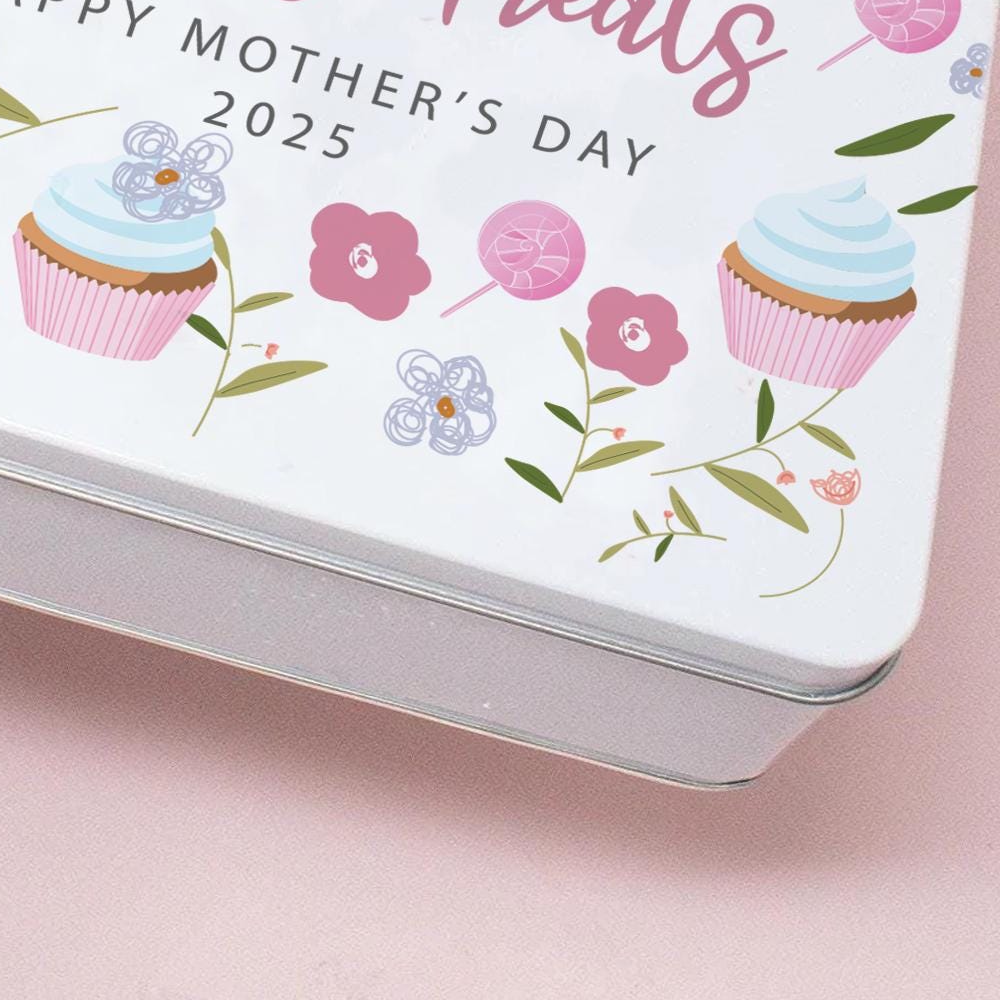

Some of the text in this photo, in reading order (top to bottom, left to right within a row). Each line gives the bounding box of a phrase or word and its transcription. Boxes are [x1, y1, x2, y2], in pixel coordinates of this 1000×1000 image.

[180, 17, 503, 136] MOTHER'S
[532, 114, 657, 177] DAY
[202, 90, 355, 160] 2025
